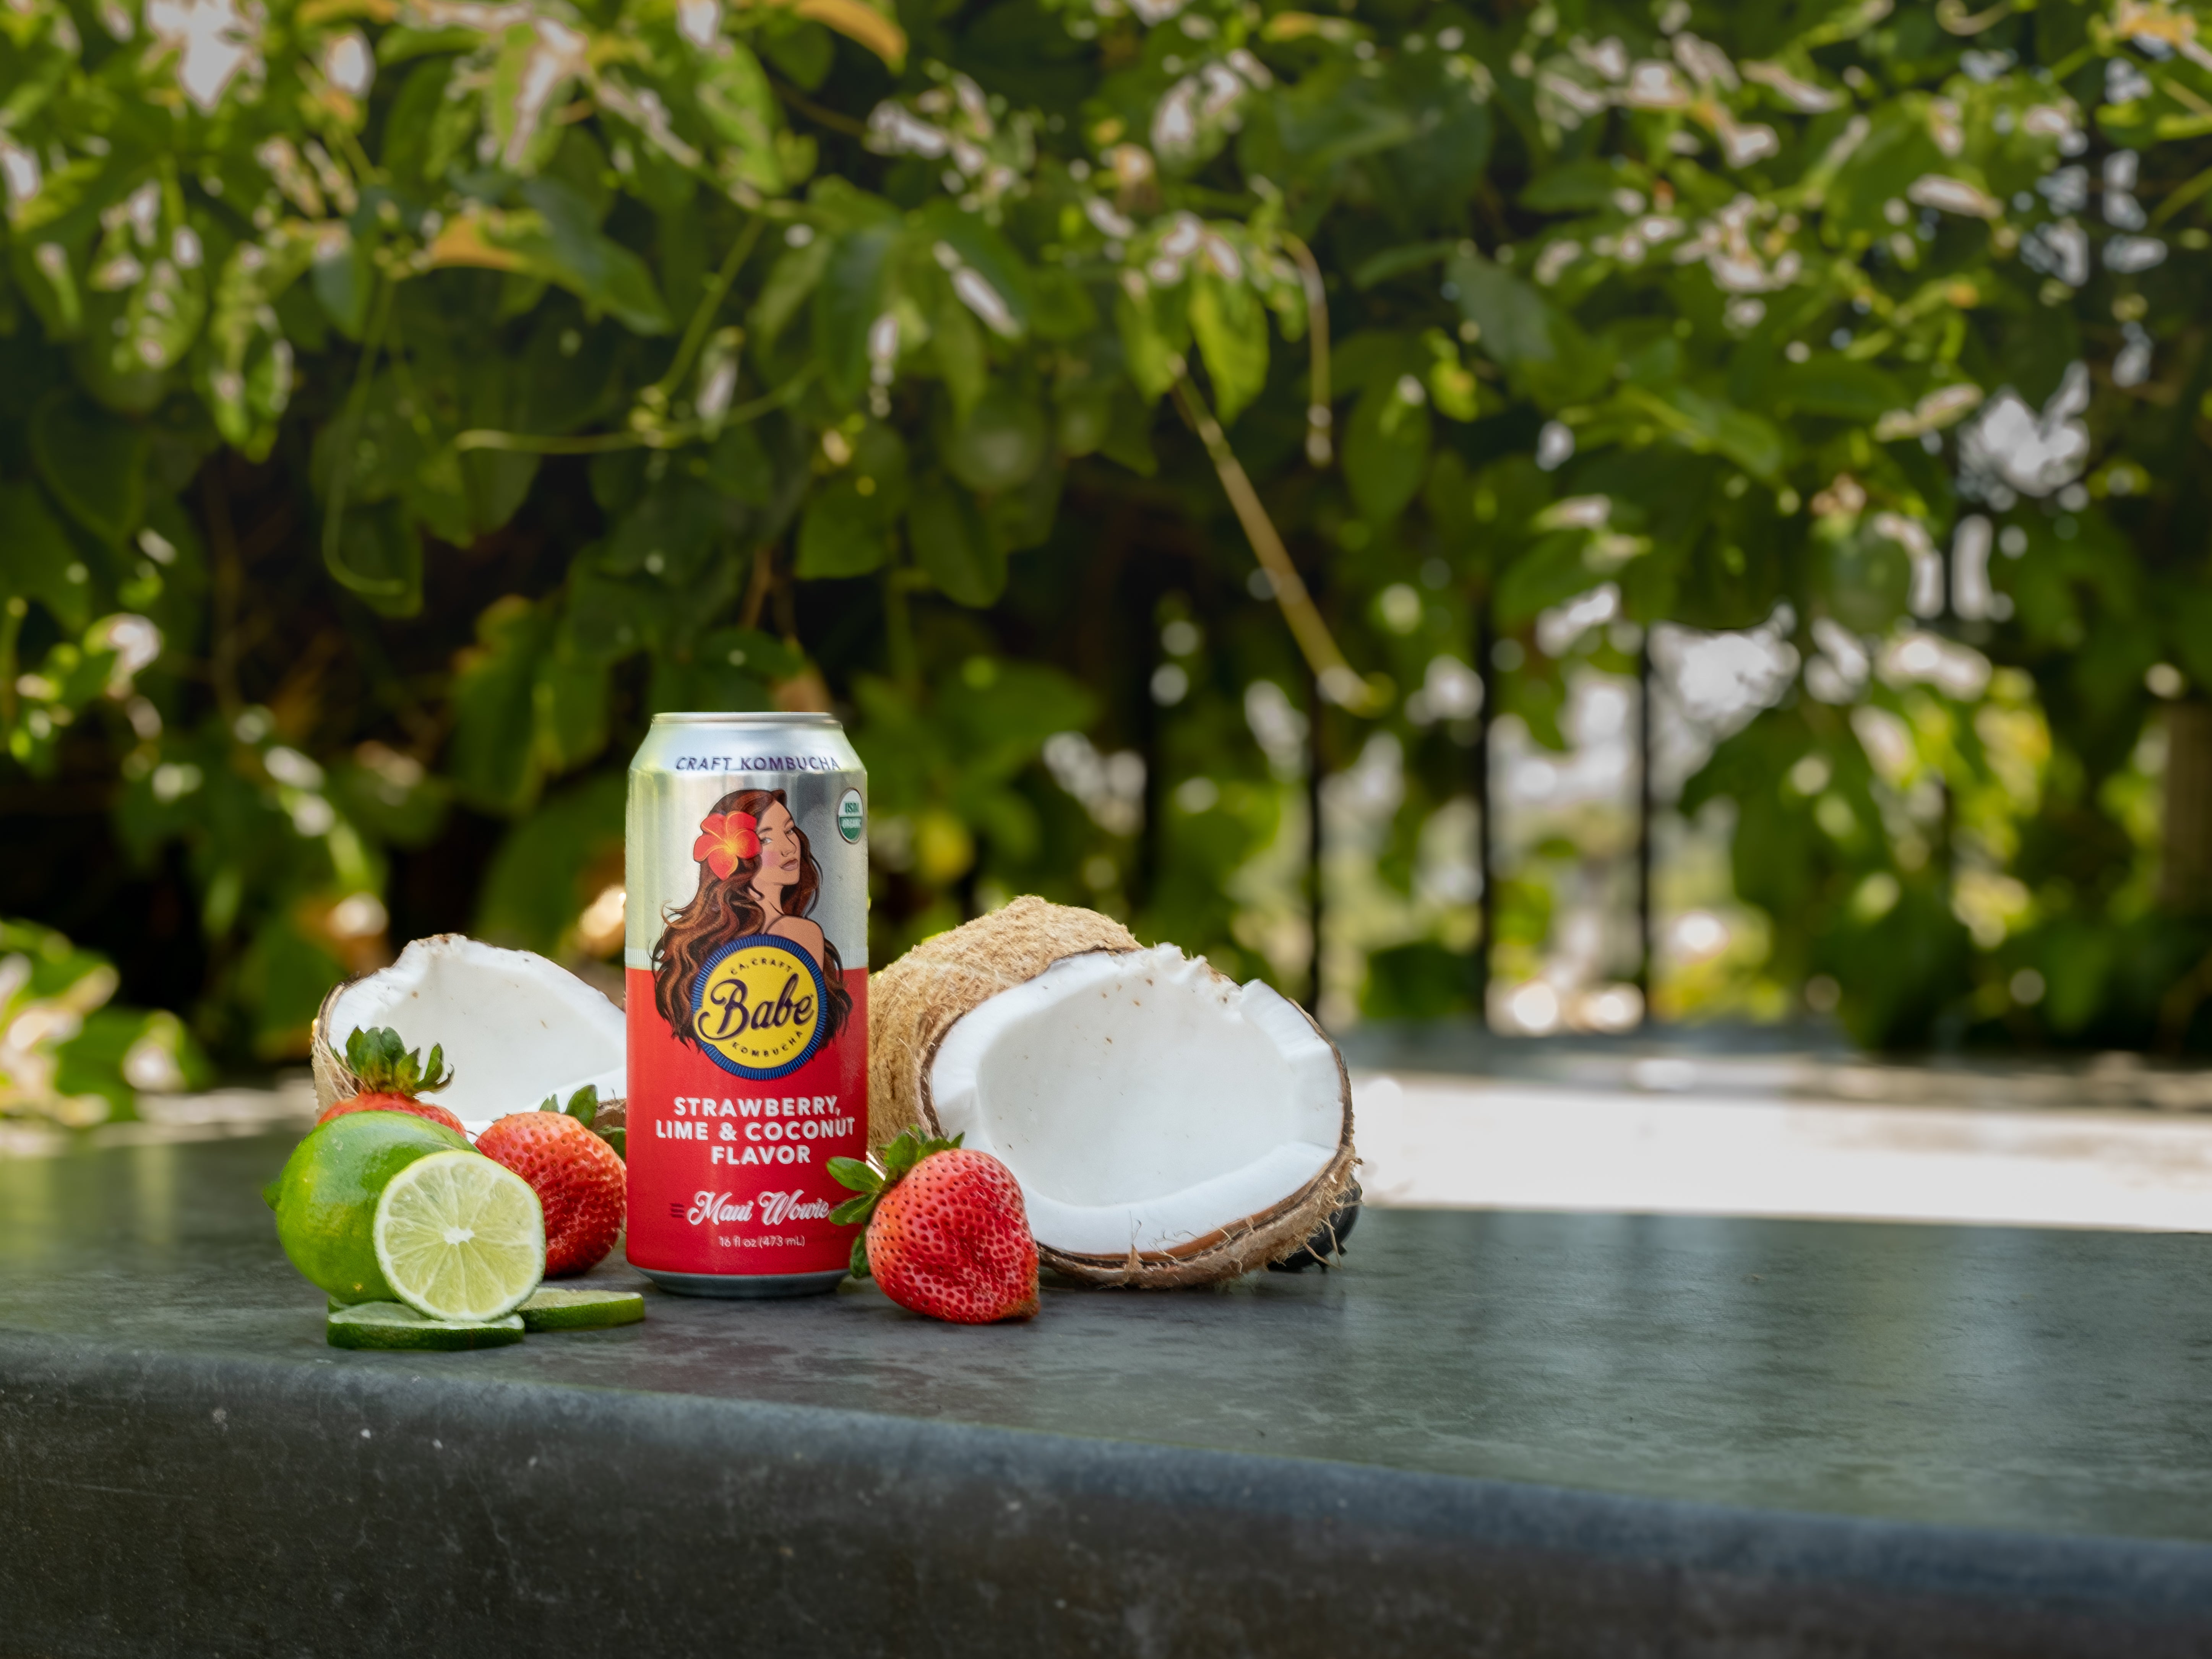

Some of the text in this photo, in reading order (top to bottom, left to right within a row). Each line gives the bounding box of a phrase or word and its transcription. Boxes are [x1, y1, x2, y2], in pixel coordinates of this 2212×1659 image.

[676, 756, 841, 771] CRAFT KOMBUCHA
[751, 957, 792, 972] CRAFT
[698, 972, 814, 1041] Babe
[732, 1030, 803, 1057] KOMBUCHA
[674, 1095, 840, 1117] STRAWBERRY,
[656, 1116, 855, 1141] LIME & COCONUT
[711, 1144, 810, 1165] FLAVOR
[687, 1188, 830, 1226] Maui Wowie
[719, 1235, 805, 1249] 16 fl oz (473 mL)
